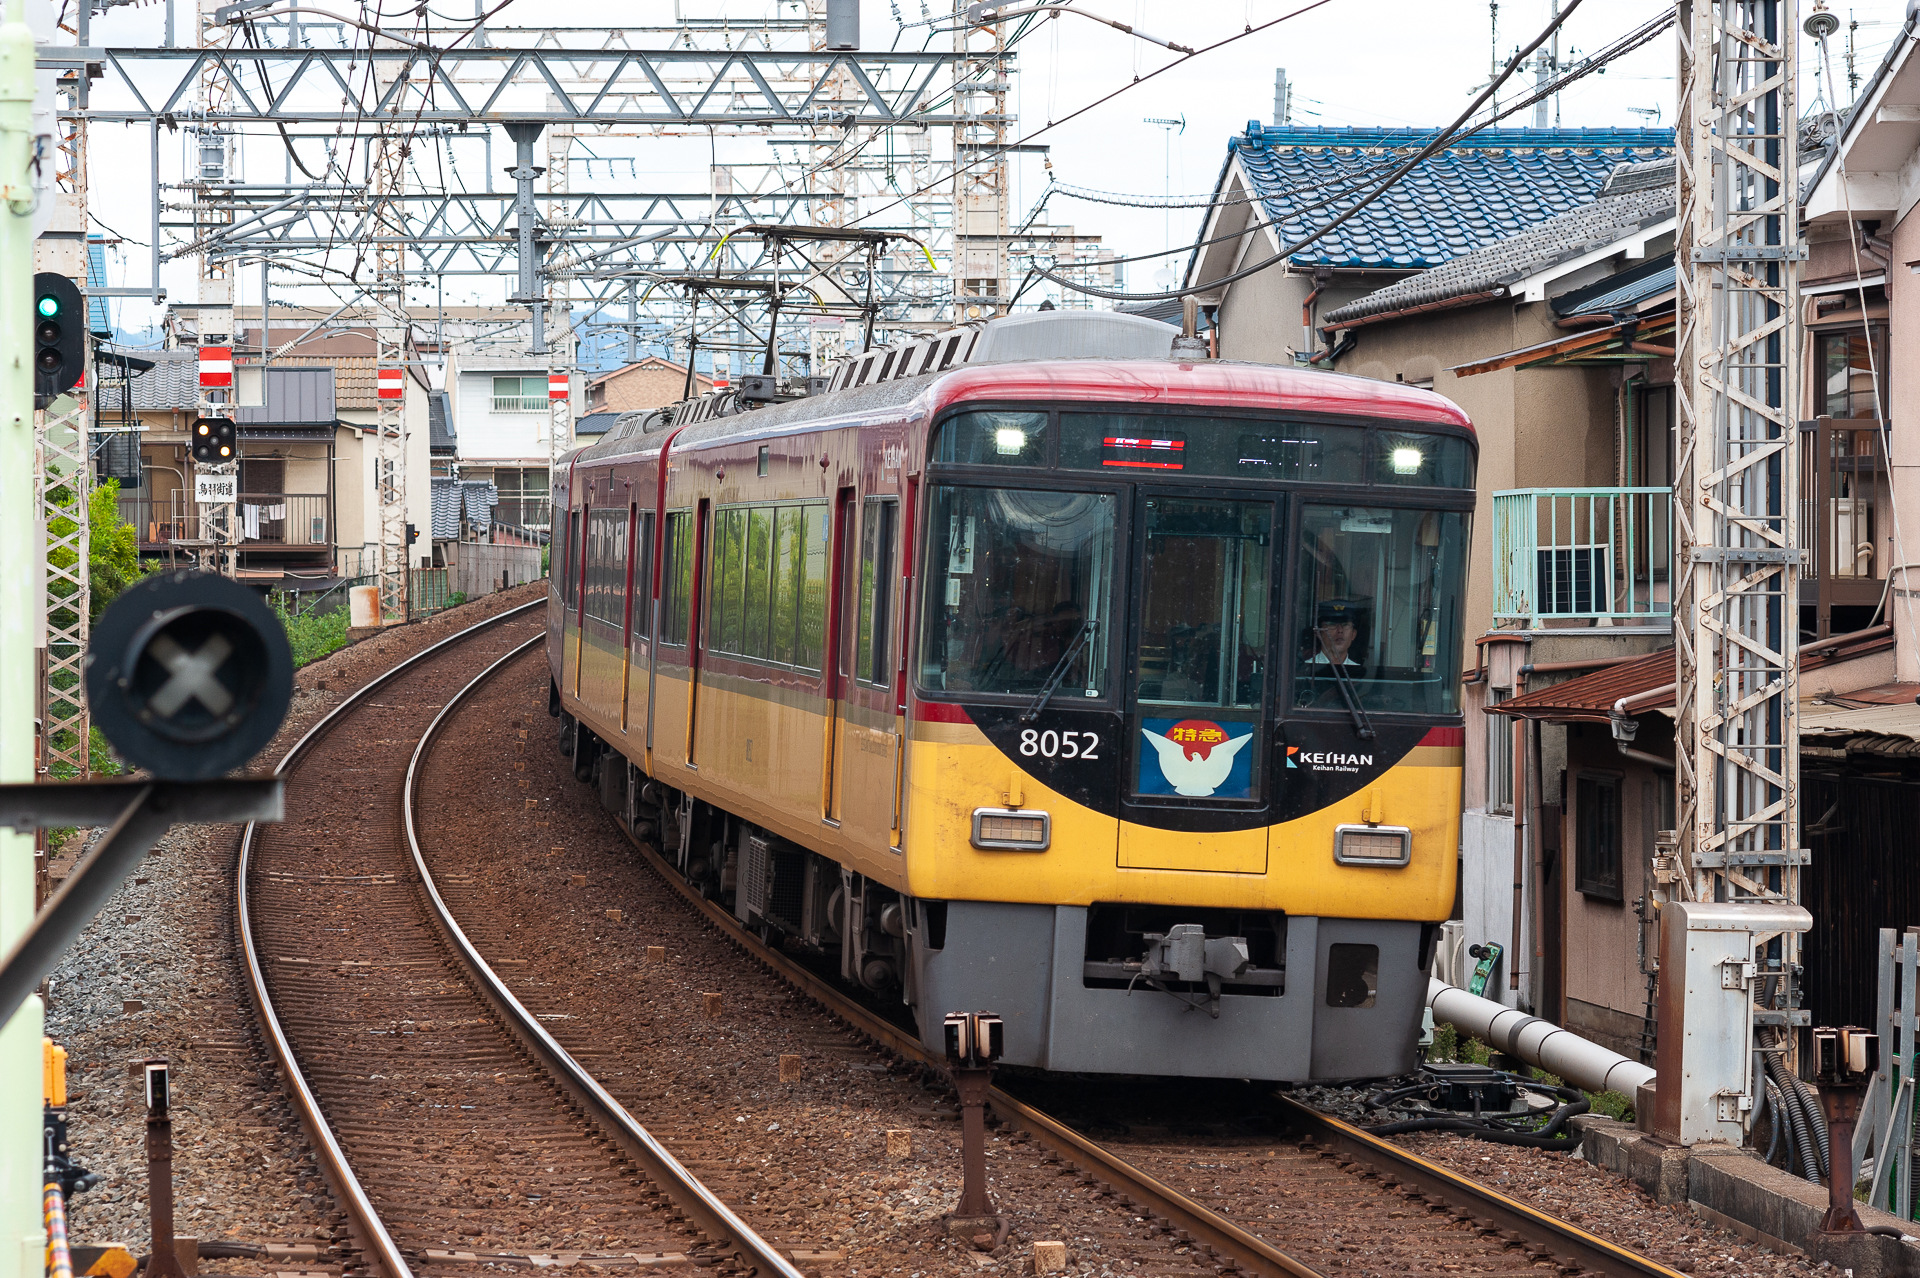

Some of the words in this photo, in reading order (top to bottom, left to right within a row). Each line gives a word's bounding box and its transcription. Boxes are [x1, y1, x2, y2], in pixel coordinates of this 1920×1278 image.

[198, 481, 234, 497] 鳥羽街道
[1173, 727, 1222, 743] 特急
[1019, 728, 1100, 760] 8052
[1300, 751, 1373, 766] KEIHAN
[1312, 764, 1334, 772] Keihan
[1335, 765, 1359, 774] Railway
